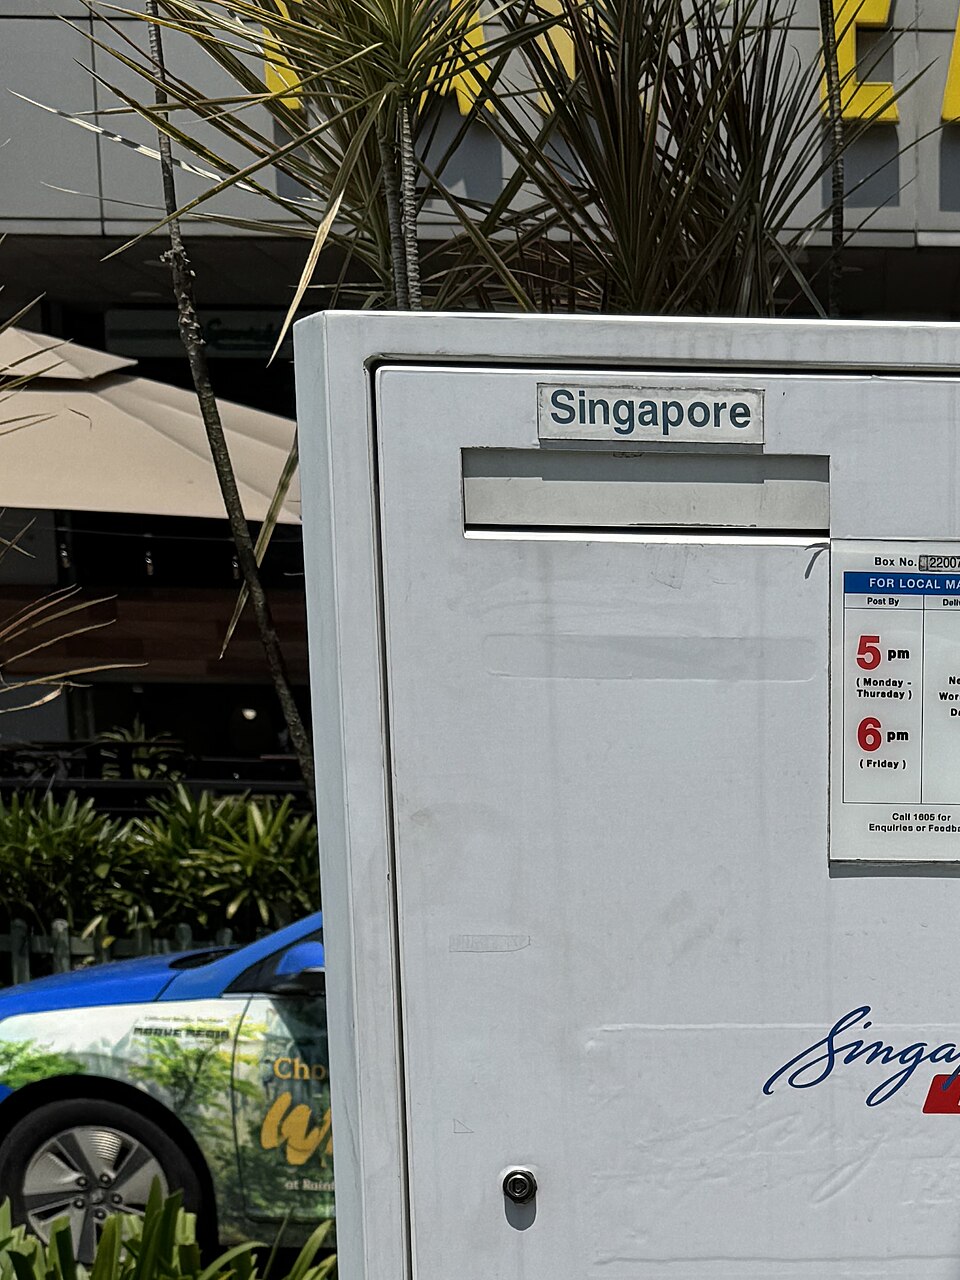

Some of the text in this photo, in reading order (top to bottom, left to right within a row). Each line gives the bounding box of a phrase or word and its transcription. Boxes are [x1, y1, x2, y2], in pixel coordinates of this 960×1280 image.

[550, 389, 751, 435] Singapore
[874, 557, 895, 566] Box
[899, 557, 917, 567] No.
[869, 578, 895, 588] FOR
[899, 579, 941, 589] LOCAL
[867, 597, 899, 607] Post By
[856, 635, 910, 671] 5 pm
[857, 716, 909, 752] 6 pm
[892, 812, 911, 821] Call
[937, 813, 952, 822] for
[868, 823, 914, 833] Enquiries
[915, 824, 927, 832] or
